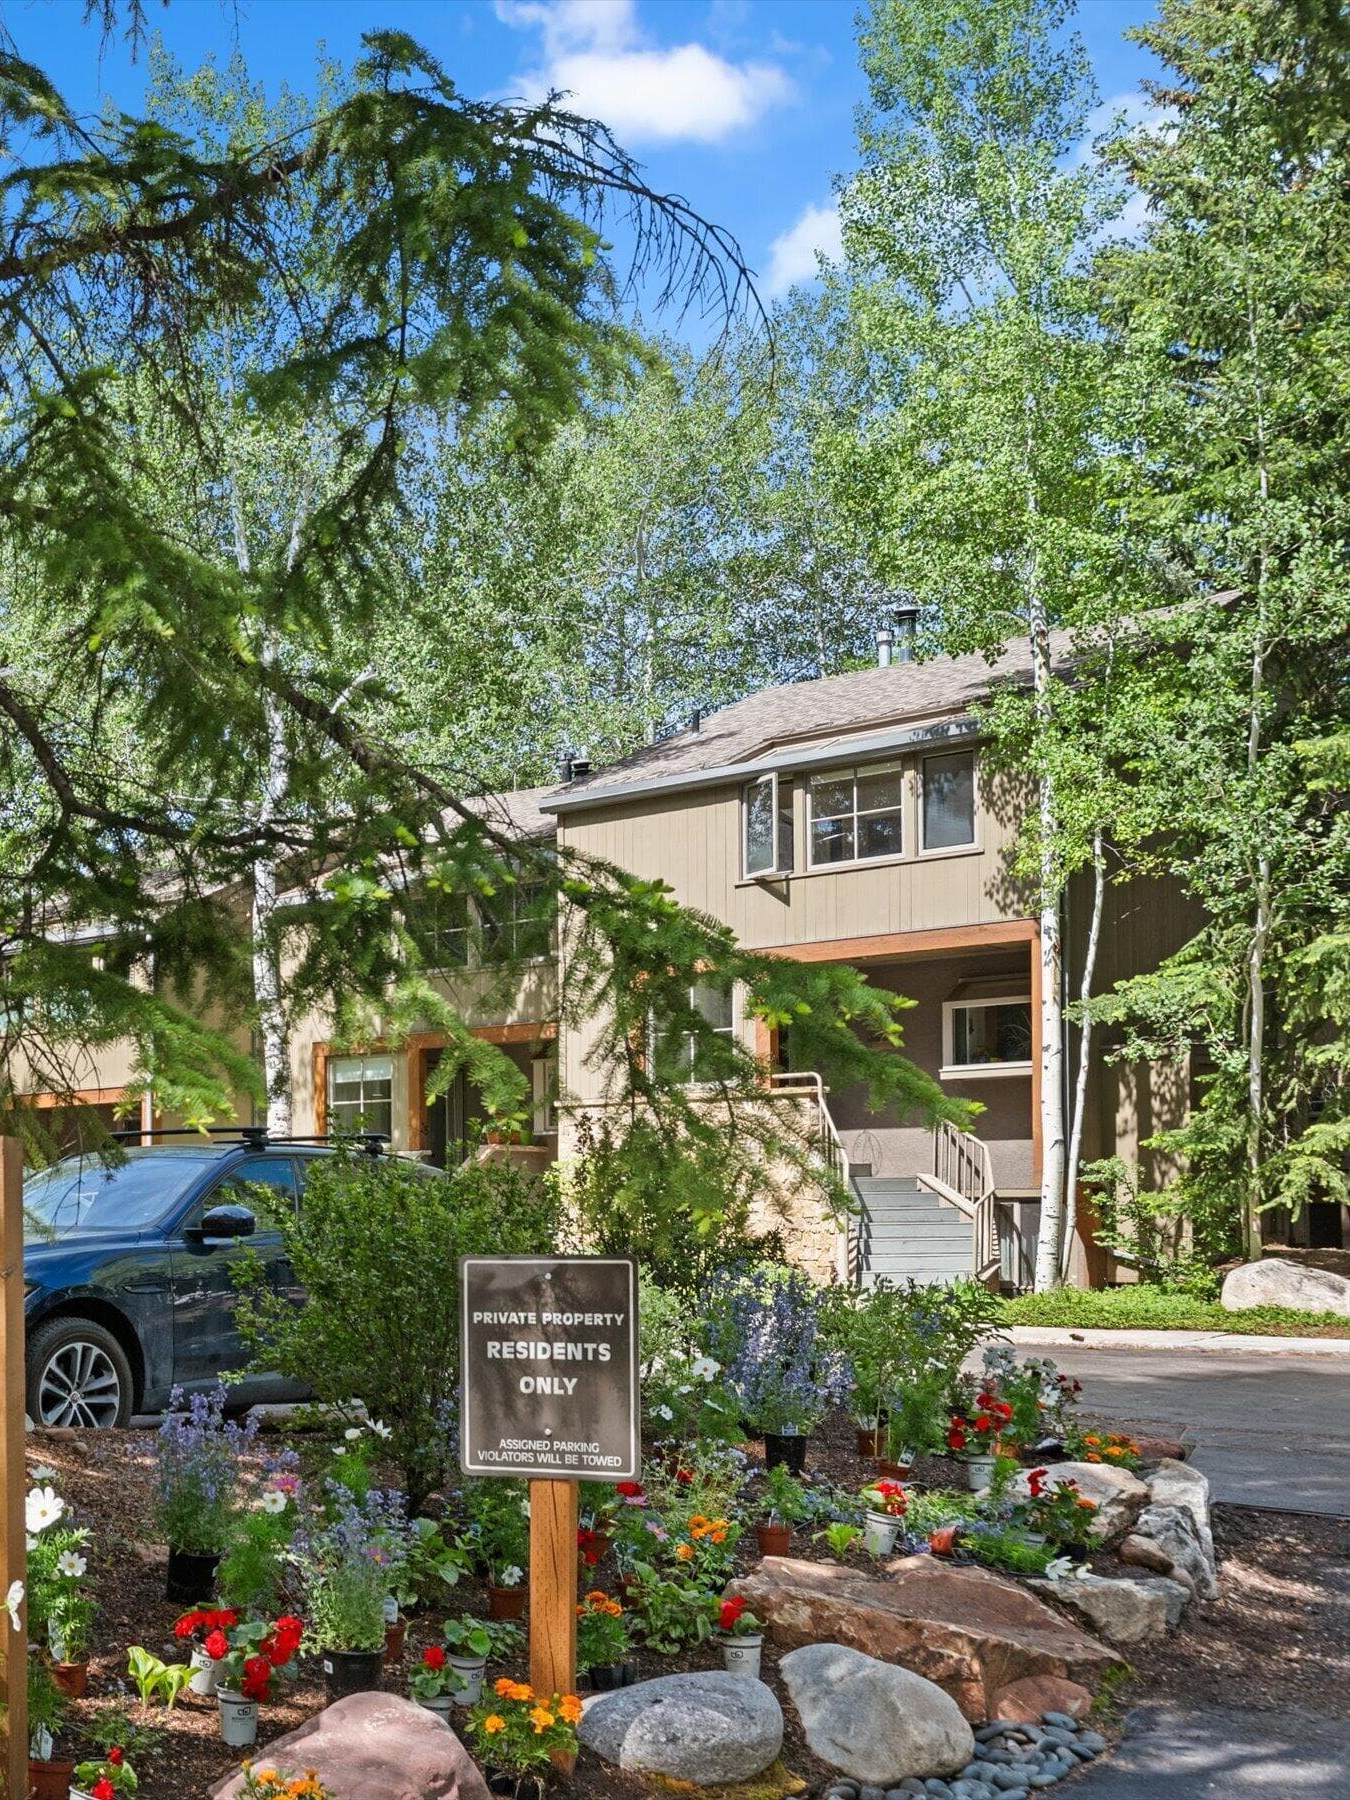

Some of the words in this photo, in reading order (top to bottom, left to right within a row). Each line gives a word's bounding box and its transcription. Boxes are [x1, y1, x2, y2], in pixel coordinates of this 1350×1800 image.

[473, 1312, 536, 1325] PRIVATE
[542, 1312, 624, 1326] PROPERTY
[487, 1341, 611, 1361] RESIDENTS
[519, 1376, 578, 1395] ONLY
[499, 1438, 550, 1451] ASSIGNED
[553, 1441, 600, 1453] PARKING
[478, 1450, 534, 1463] VIOLATORS
[537, 1453, 562, 1464] WILL
[565, 1454, 578, 1465] BE
[582, 1455, 622, 1467] TOWED
